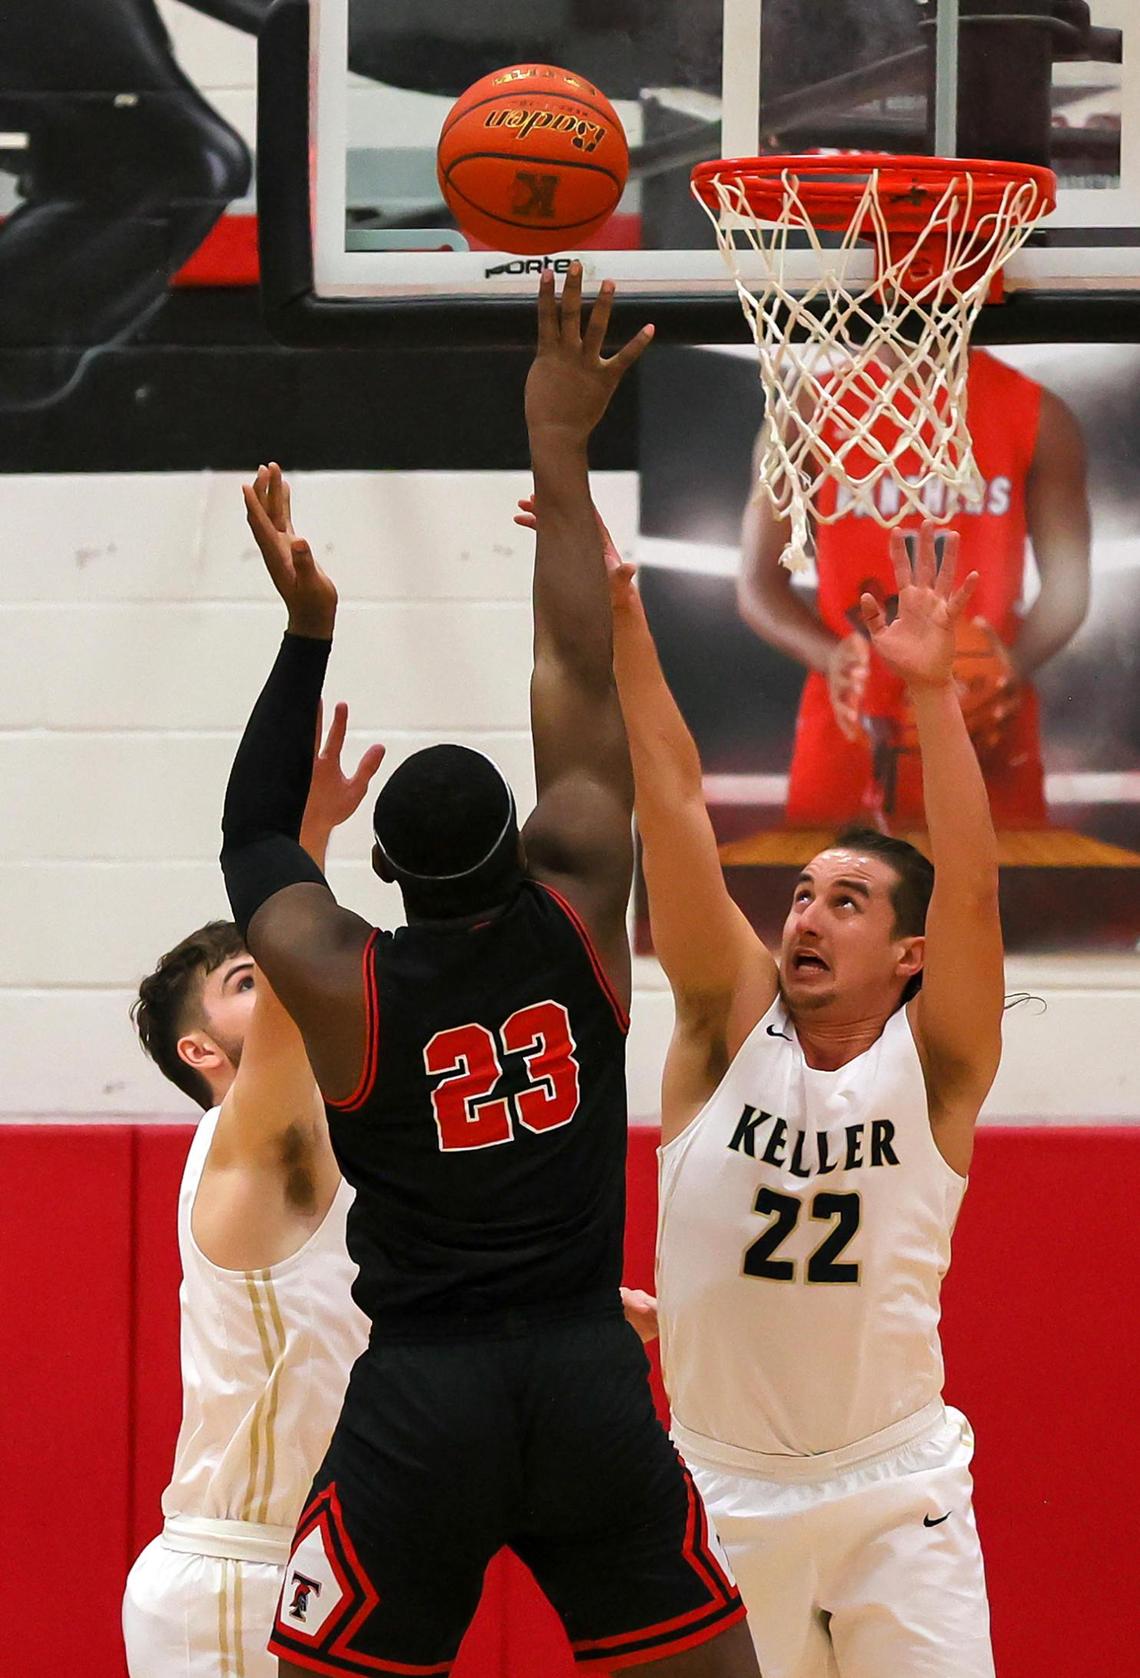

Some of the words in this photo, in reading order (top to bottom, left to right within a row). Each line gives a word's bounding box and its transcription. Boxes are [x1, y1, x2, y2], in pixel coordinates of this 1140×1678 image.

[484, 109, 607, 153] Baden
[511, 171, 560, 218] K
[423, 999, 581, 1152] 23
[728, 1103, 900, 1178] KELLER
[739, 1183, 862, 1286] 22
